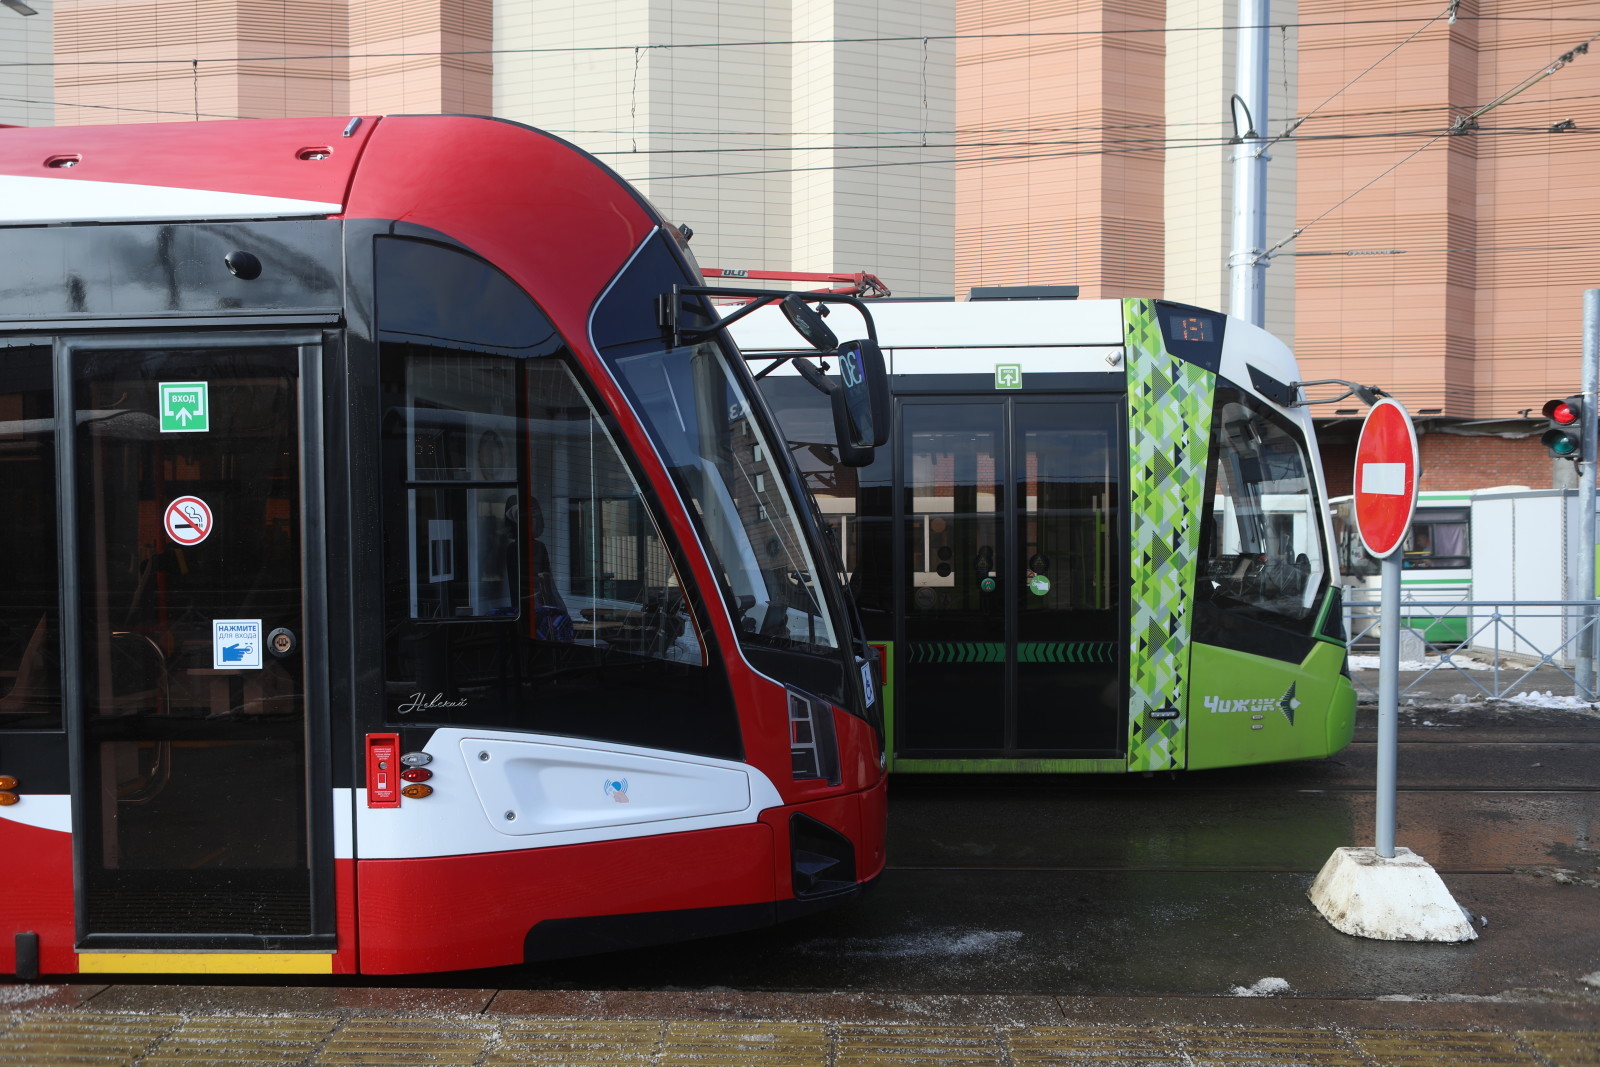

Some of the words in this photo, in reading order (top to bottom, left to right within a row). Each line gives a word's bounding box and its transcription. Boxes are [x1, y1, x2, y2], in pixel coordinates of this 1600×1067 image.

[171, 394, 196, 404] ВХОД
[397, 692, 468, 714] Невский
[1203, 695, 1276, 713] Чижик
